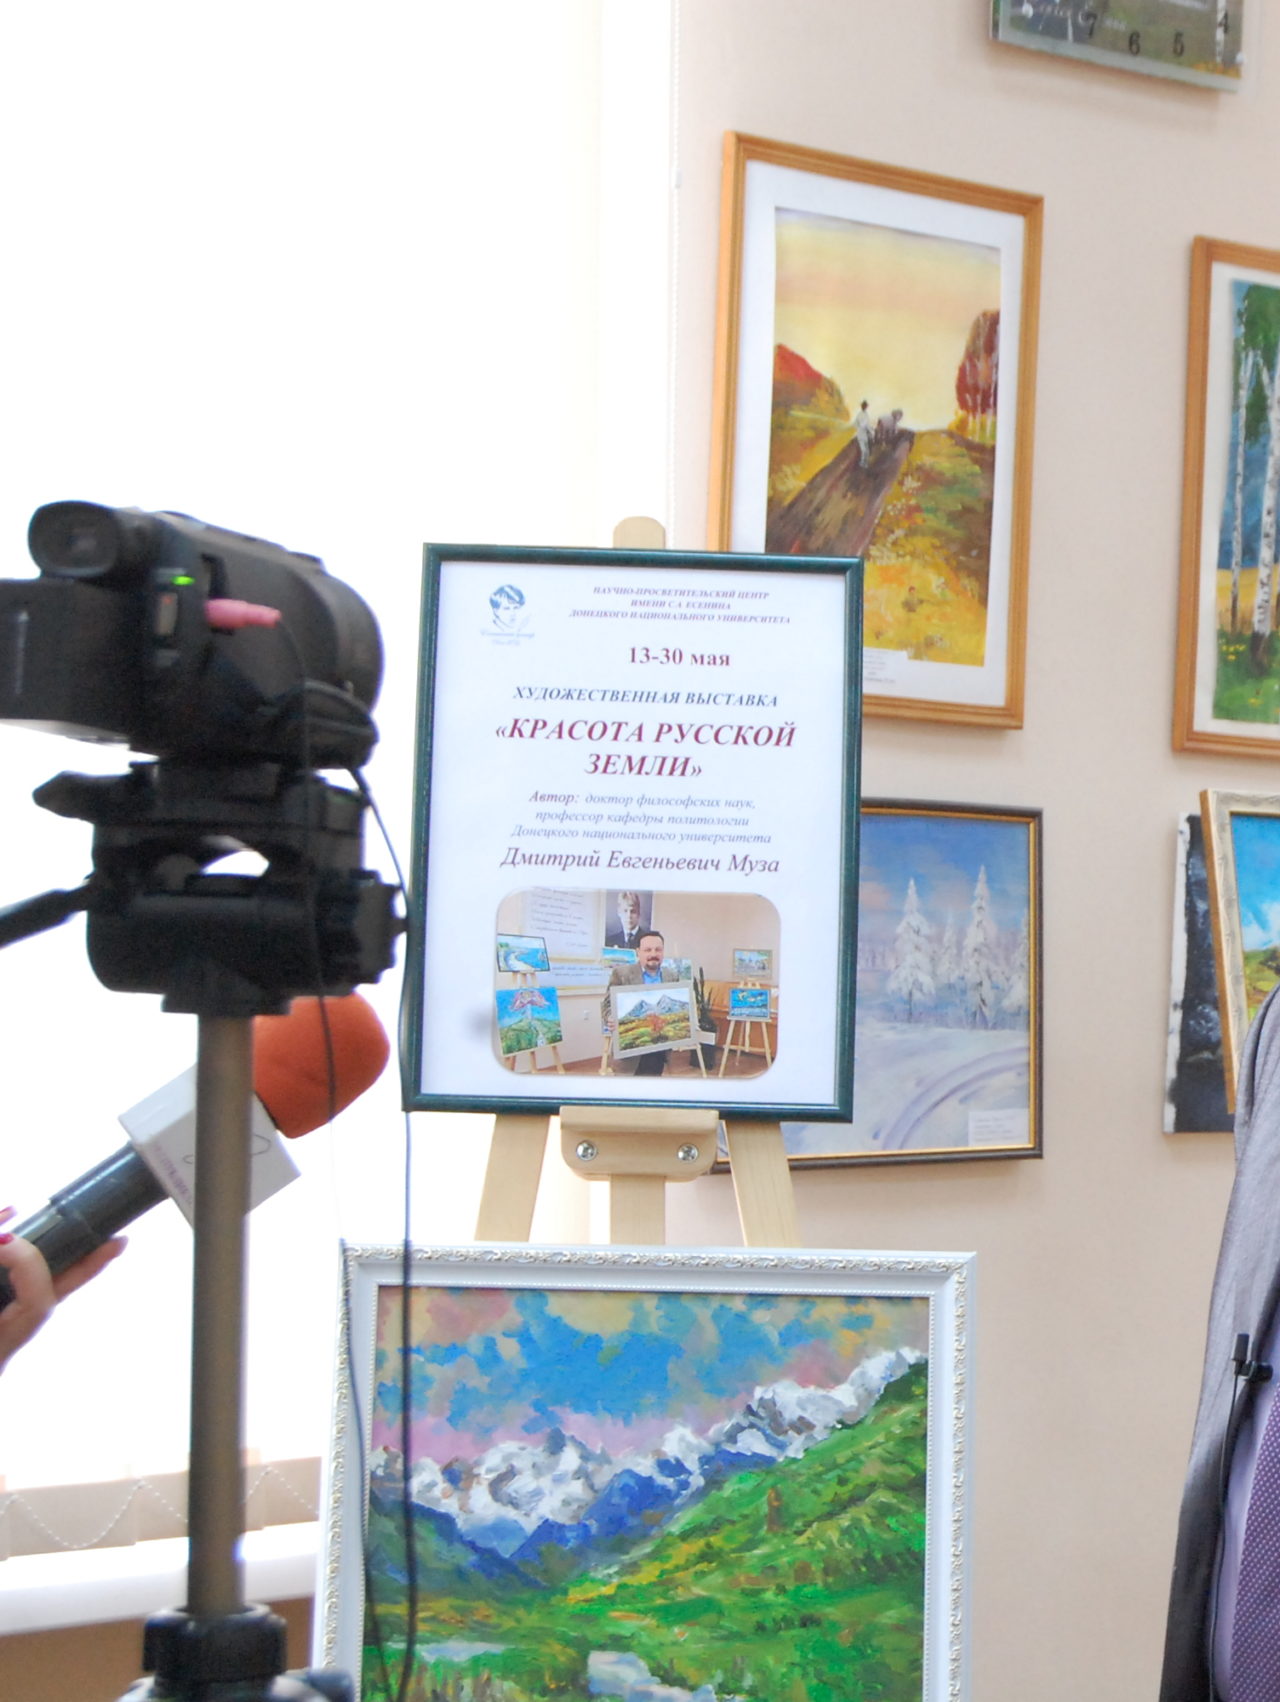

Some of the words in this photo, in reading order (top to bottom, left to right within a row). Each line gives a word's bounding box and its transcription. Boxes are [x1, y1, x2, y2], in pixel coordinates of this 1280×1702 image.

[1084, 12, 1097, 38] 7
[1218, 11, 1230, 34] 4
[1128, 31, 1141, 55] 6
[1173, 31, 1185, 56] 5
[593, 586, 736, 598] НАУЧНО-ПРОСВЕТИТЕЛЬСКИЙ
[737, 591, 769, 600] ЦЕНТР
[630, 599, 666, 608] ИМЕНИ
[685, 602, 731, 610] ЕСЕНИНА
[569, 609, 628, 619] ДОНЕЦКОГО
[630, 611, 715, 622] НАЦИОНАЛЬНОГО
[716, 614, 790, 624] УНИВЕРСИТЕТА
[629, 646, 683, 665] 13-30
[690, 653, 730, 667] мая
[513, 686, 679, 703] ХУДОЖЕСТВЕННАЯ
[685, 692, 778, 707] ВЫСТАВКА
[496, 718, 645, 743] «КРАСОТА
[653, 721, 797, 748] РУССКОЙ
[584, 753, 702, 778] ЗЕМЛИ»
[529, 791, 580, 806] Автор:
[585, 794, 634, 807] доктор
[636, 794, 721, 809] философских
[724, 800, 757, 810] наук,
[535, 810, 604, 823] профессор
[607, 814, 664, 826] кафедры
[667, 815, 750, 827] политологии
[511, 824, 580, 838] Донецкого
[582, 830, 677, 842] национального
[678, 833, 772, 845] университета
[500, 847, 600, 872] Дмитрий
[606, 850, 721, 872] Евгеньевич
[727, 854, 781, 877] Муза
